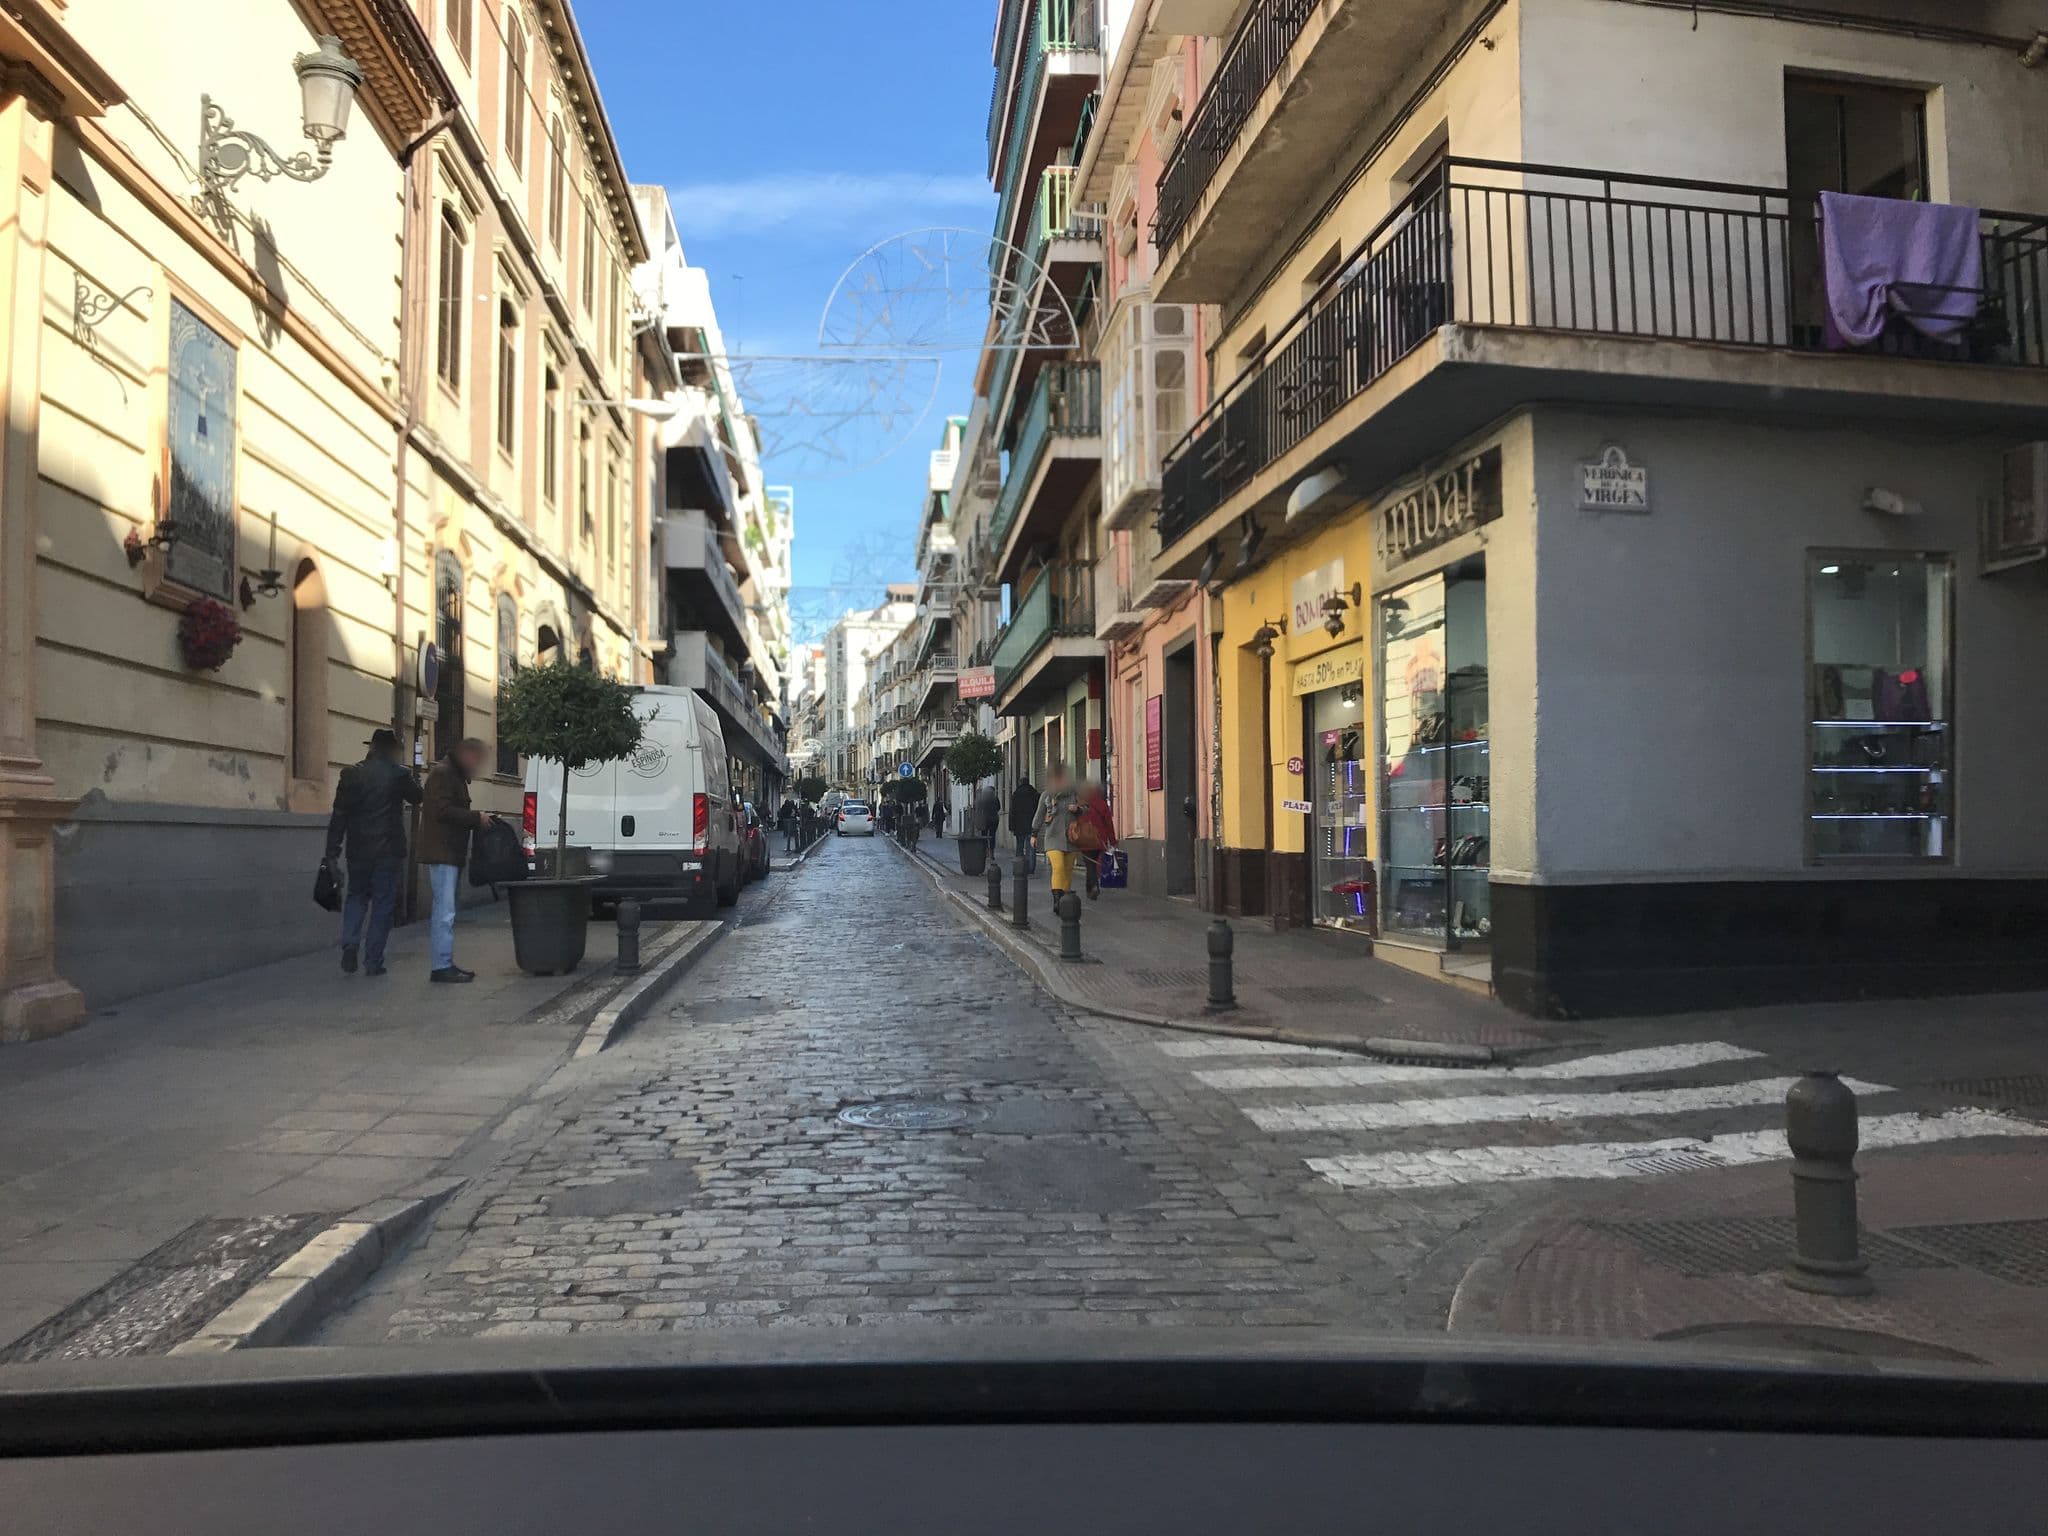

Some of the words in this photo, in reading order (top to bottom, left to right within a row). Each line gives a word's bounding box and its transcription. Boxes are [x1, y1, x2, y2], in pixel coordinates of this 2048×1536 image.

[1584, 488, 1644, 504] VIRGEN
[1315, 660, 1335, 684] 50%
[959, 676, 996, 687] ALQUILA
[631, 749, 666, 768] ESPINOSA
[1283, 800, 1310, 811] PLATA
